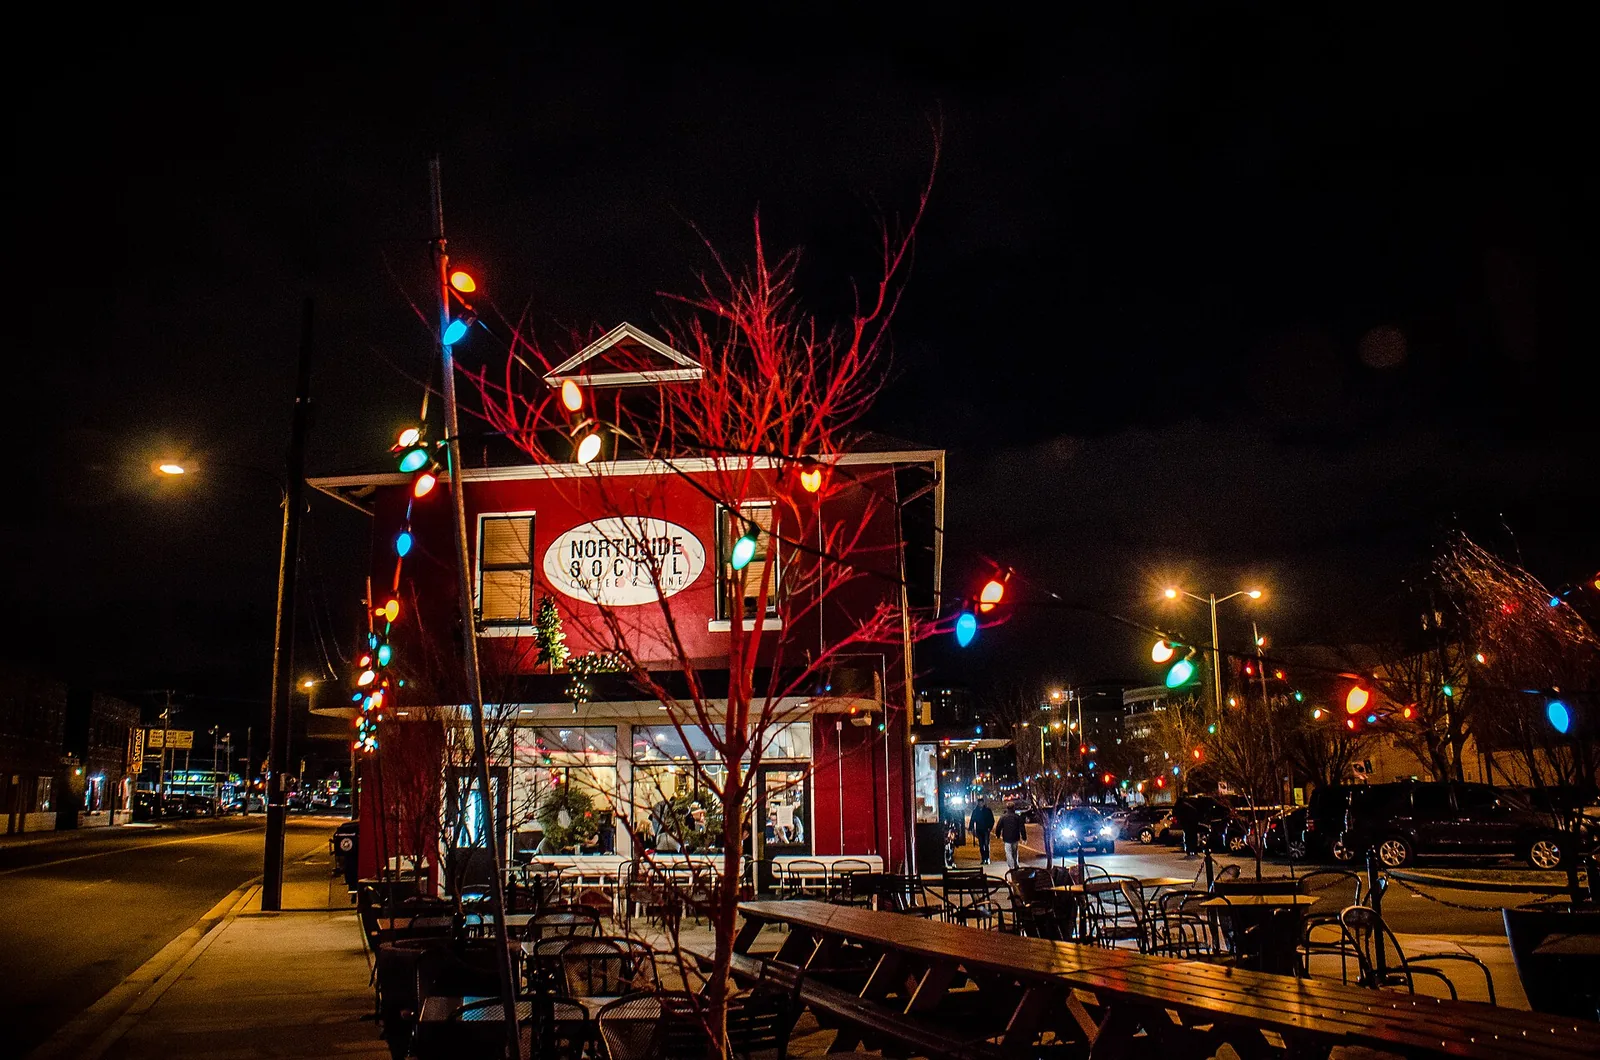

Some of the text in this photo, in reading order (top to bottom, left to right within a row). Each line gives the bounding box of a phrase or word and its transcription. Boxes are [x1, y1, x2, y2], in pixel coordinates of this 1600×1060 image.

[570, 556, 682, 577] SOCIL
[631, 577, 638, 587] &
[133, 729, 142, 761] SAFFRON
